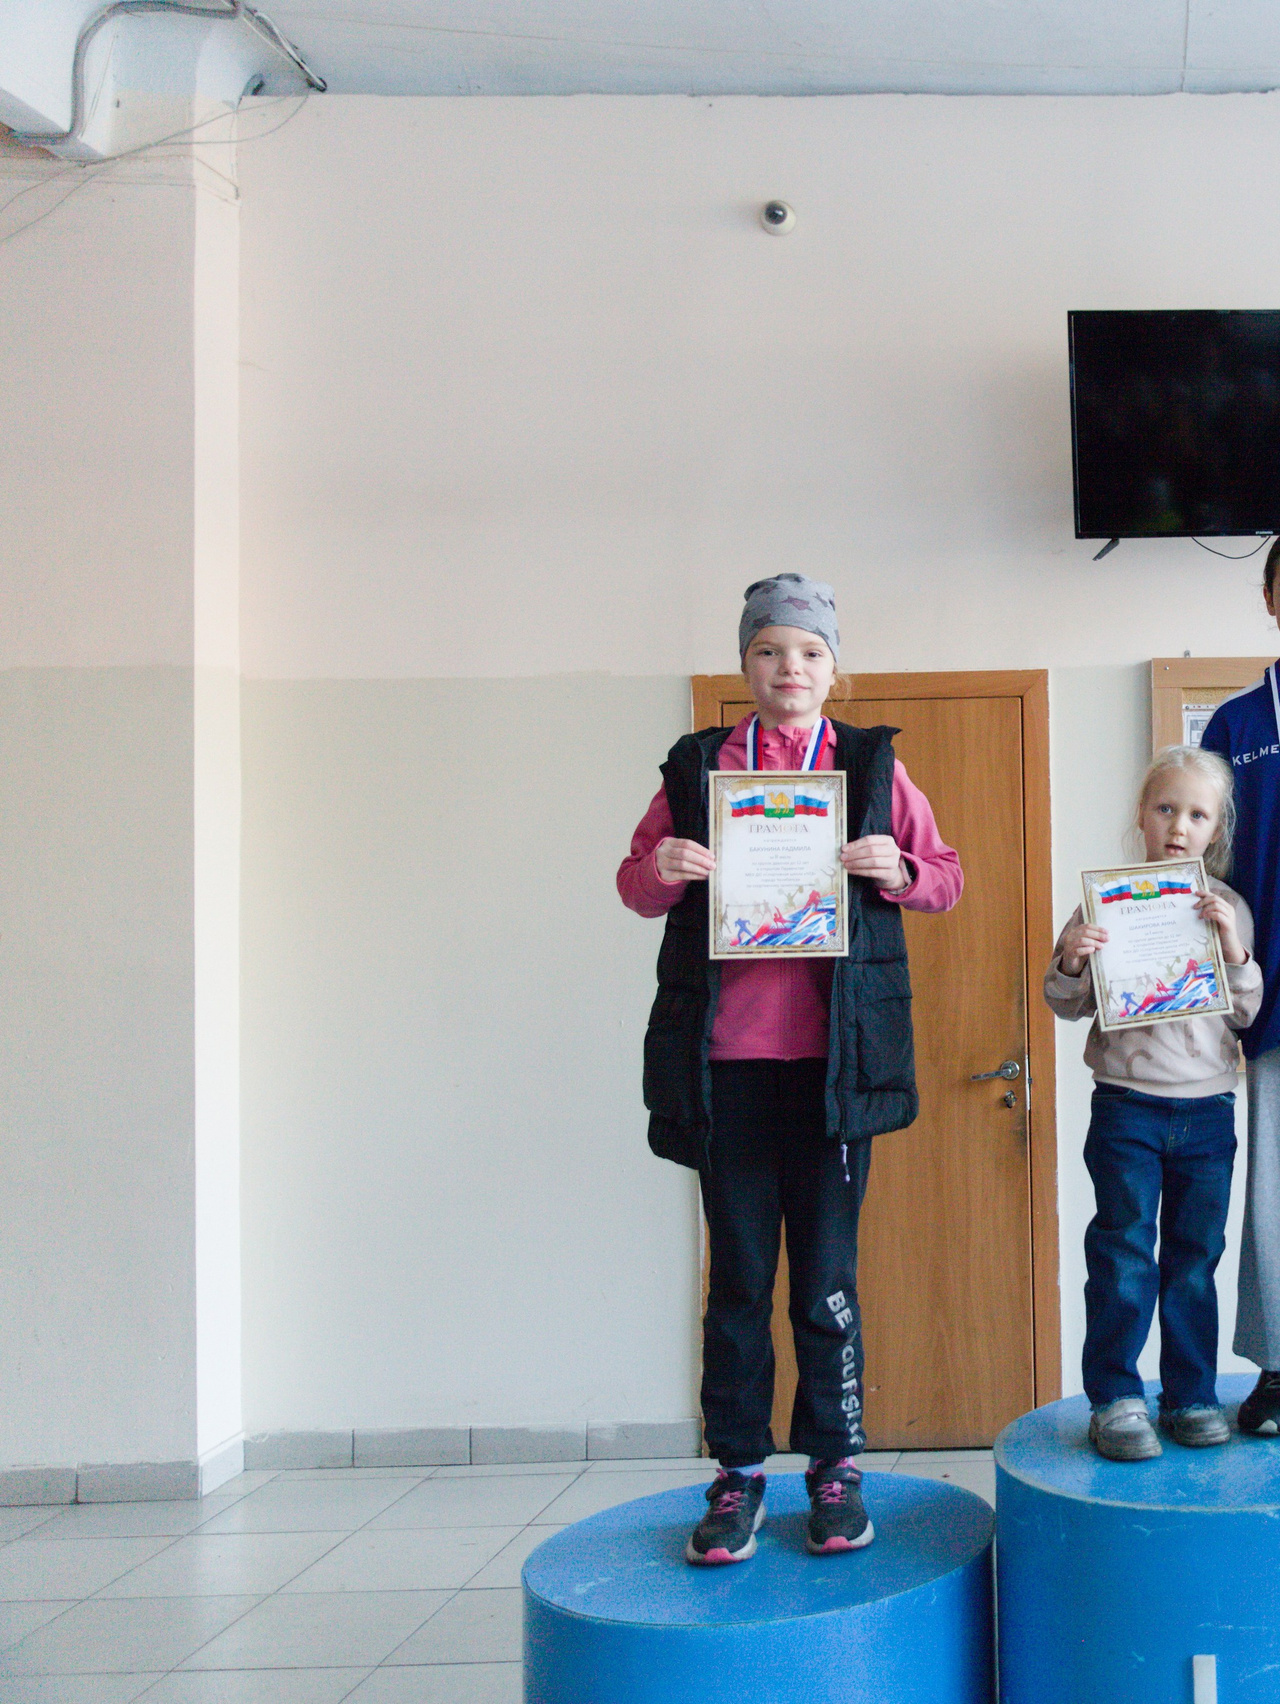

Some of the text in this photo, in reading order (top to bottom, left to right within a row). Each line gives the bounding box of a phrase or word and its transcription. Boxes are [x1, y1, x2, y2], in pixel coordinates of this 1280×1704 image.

[1232, 744, 1279, 766] KELME
[749, 824, 809, 833] ГРАМОТА
[1120, 901, 1176, 915] ГРАМОТА
[826, 1290, 853, 1329] BE
